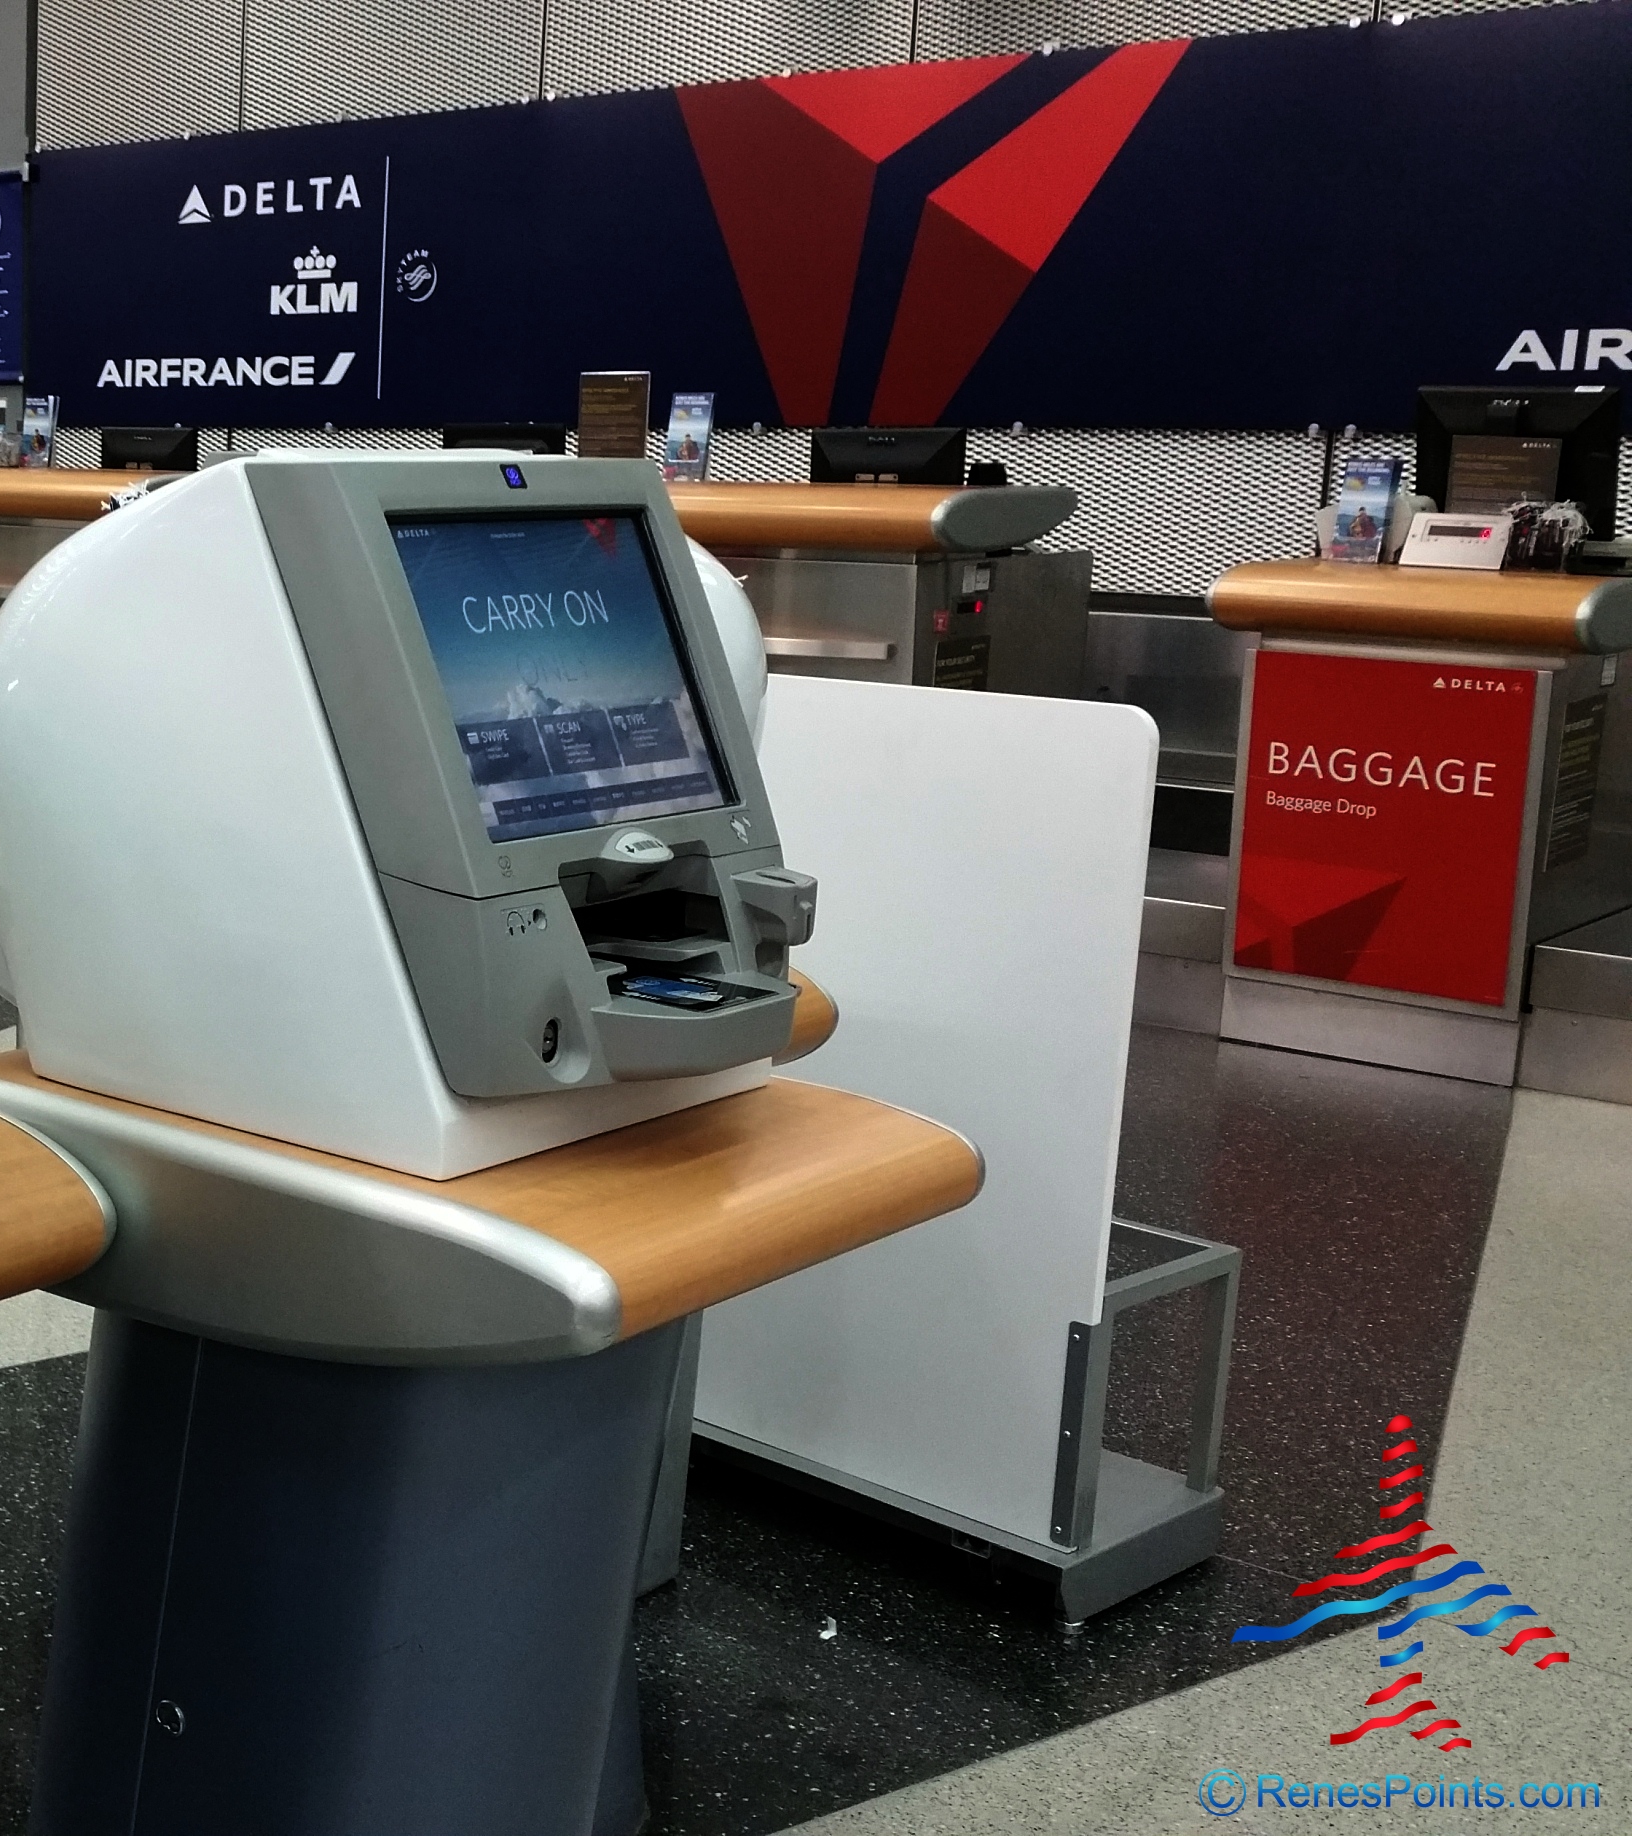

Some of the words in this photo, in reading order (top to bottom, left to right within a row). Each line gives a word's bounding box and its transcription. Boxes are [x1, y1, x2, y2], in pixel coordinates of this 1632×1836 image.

[223, 174, 362, 218] DELTA
[396, 249, 429, 293] SKYTEAM
[269, 281, 358, 315] KLM
[96, 355, 315, 388] AIRFRANCE
[404, 529, 429, 538] DELTA
[462, 592, 555, 634] CARRY
[563, 589, 609, 626] ON
[1451, 678, 1506, 693] DELTA
[556, 720, 581, 734] SCAN
[625, 713, 647, 726] TYPE
[480, 729, 510, 744] SWIPE
[1268, 741, 1497, 797] BAGGAGE
[1266, 791, 1332, 814] Baggage
[1337, 798, 1377, 820] Drop
